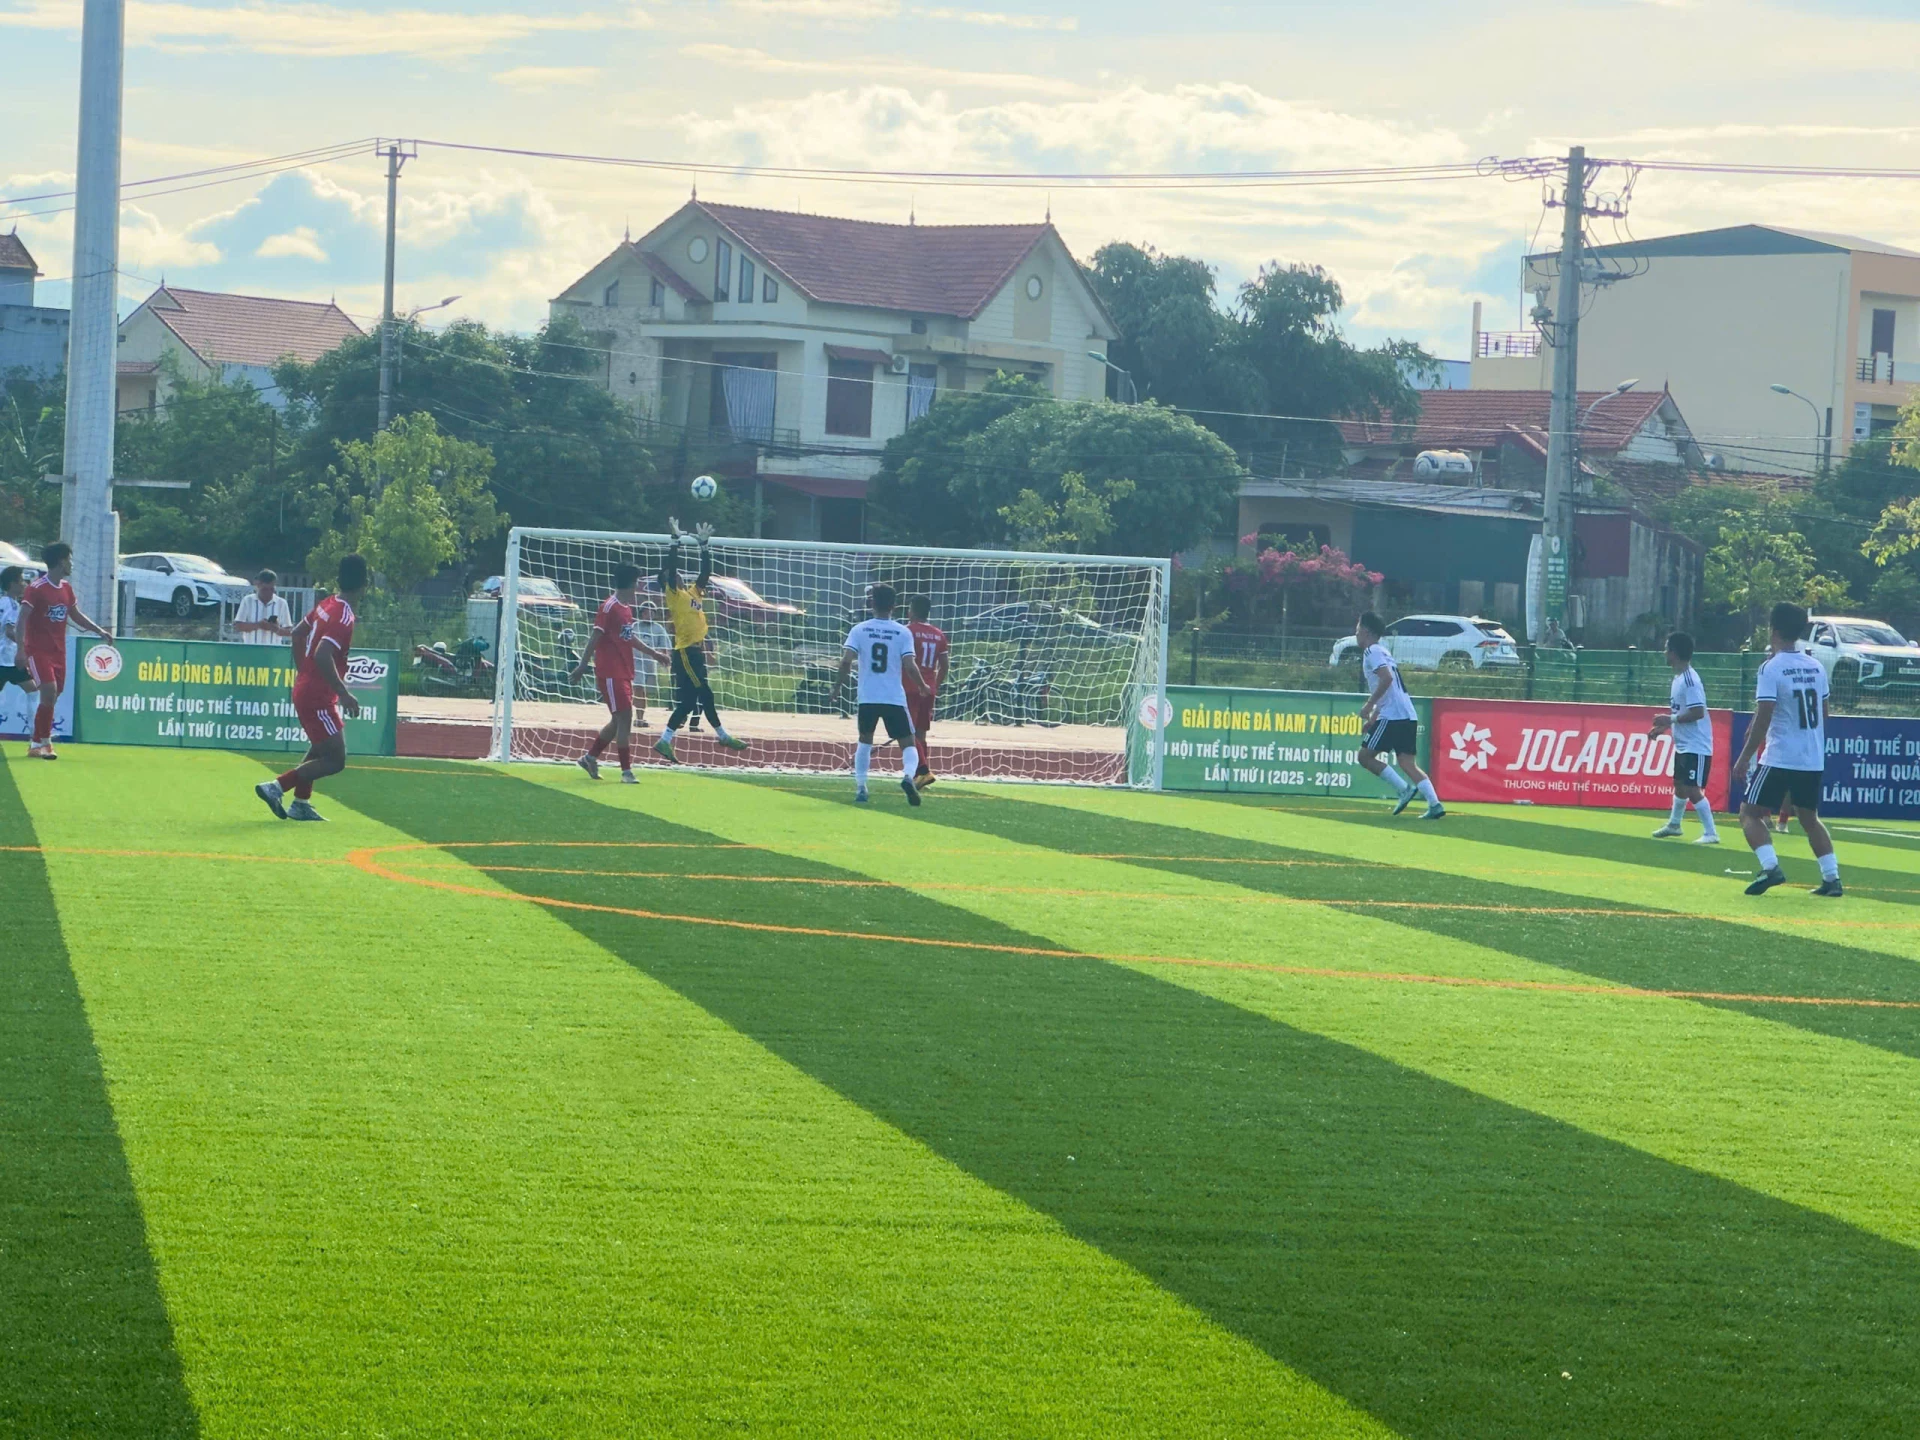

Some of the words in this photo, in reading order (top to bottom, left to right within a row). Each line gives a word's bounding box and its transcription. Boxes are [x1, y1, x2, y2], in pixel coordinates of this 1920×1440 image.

[871, 642, 888, 673] 9
[921, 641, 936, 668] 11
[138, 656, 168, 682] GIẢI
[171, 660, 210, 684] BÓNG
[214, 661, 232, 685] ĐÁ
[236, 666, 270, 687] NAM
[273, 668, 281, 687] 7
[95, 694, 118, 713] ĐẠI
[122, 693, 145, 714] HỘI
[149, 692, 175, 713] THỂ
[177, 699, 204, 716] DỤC
[207, 695, 233, 714] THỂ
[236, 701, 269, 717] THAO
[1792, 688, 1818, 729] 18
[188, 720, 215, 738] THỨ
[217, 724, 221, 739] I
[225, 724, 263, 740] (2025
[275, 726, 311, 743] 2026
[1182, 703, 1210, 728] GIẢI
[1213, 707, 1251, 730] BÓNG
[1253, 709, 1272, 731] ĐÁ
[1275, 712, 1306, 733] NAM
[1309, 715, 1318, 733] 7
[1321, 712, 1362, 735] NGƯỜI
[1171, 740, 1193, 759] HỘI
[1196, 739, 1220, 758] THỂ
[1223, 745, 1248, 762] DỤC
[1251, 741, 1276, 761] THỂ
[1278, 747, 1310, 762] THAO
[1313, 744, 1342, 763] TỈNH
[1825, 737, 1840, 756] ẠI
[1844, 735, 1870, 758] HỘI
[1873, 733, 1902, 756] THỂ
[1233, 766, 1259, 782] THỨ
[1260, 769, 1265, 783] I
[1268, 770, 1304, 785] (2025
[1315, 772, 1351, 788] 2026)
[1688, 769, 1696, 780] 3
[1852, 758, 1887, 779] TỈNH
[1891, 760, 1920, 782] QUẢ
[1503, 779, 1546, 790] THƯƠNG
[1548, 780, 1570, 792] HIỆU
[1592, 783, 1619, 793] THAO
[1621, 782, 1641, 794] ĐẾN
[1823, 781, 1852, 803] LẦN
[1856, 784, 1886, 804] THỨ
[1889, 788, 1894, 804] I
[1899, 788, 1920, 806] (20
